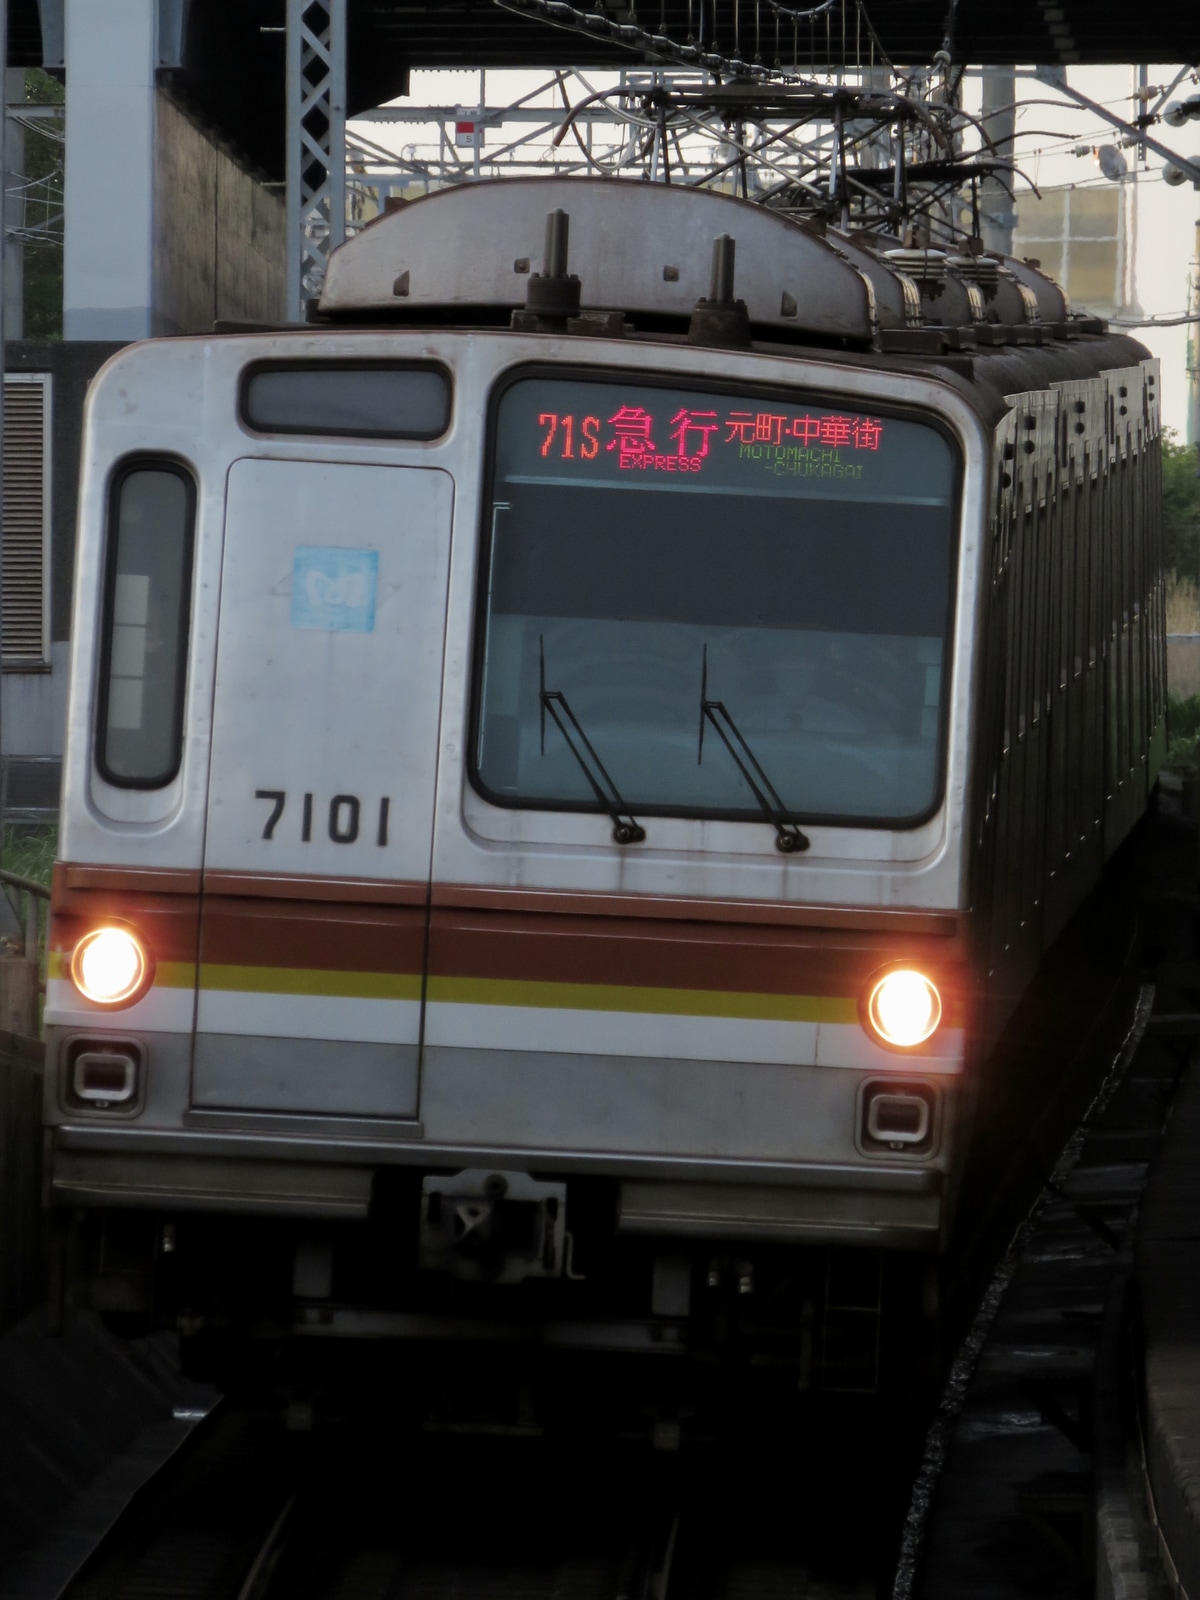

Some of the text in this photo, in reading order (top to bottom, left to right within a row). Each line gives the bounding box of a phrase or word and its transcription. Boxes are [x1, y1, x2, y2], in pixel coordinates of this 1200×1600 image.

[539, 412, 600, 460] 71S
[739, 443, 840, 463] MOTOMACHI
[618, 453, 702, 472] EXPRESS
[254, 789, 391, 847] 7101
